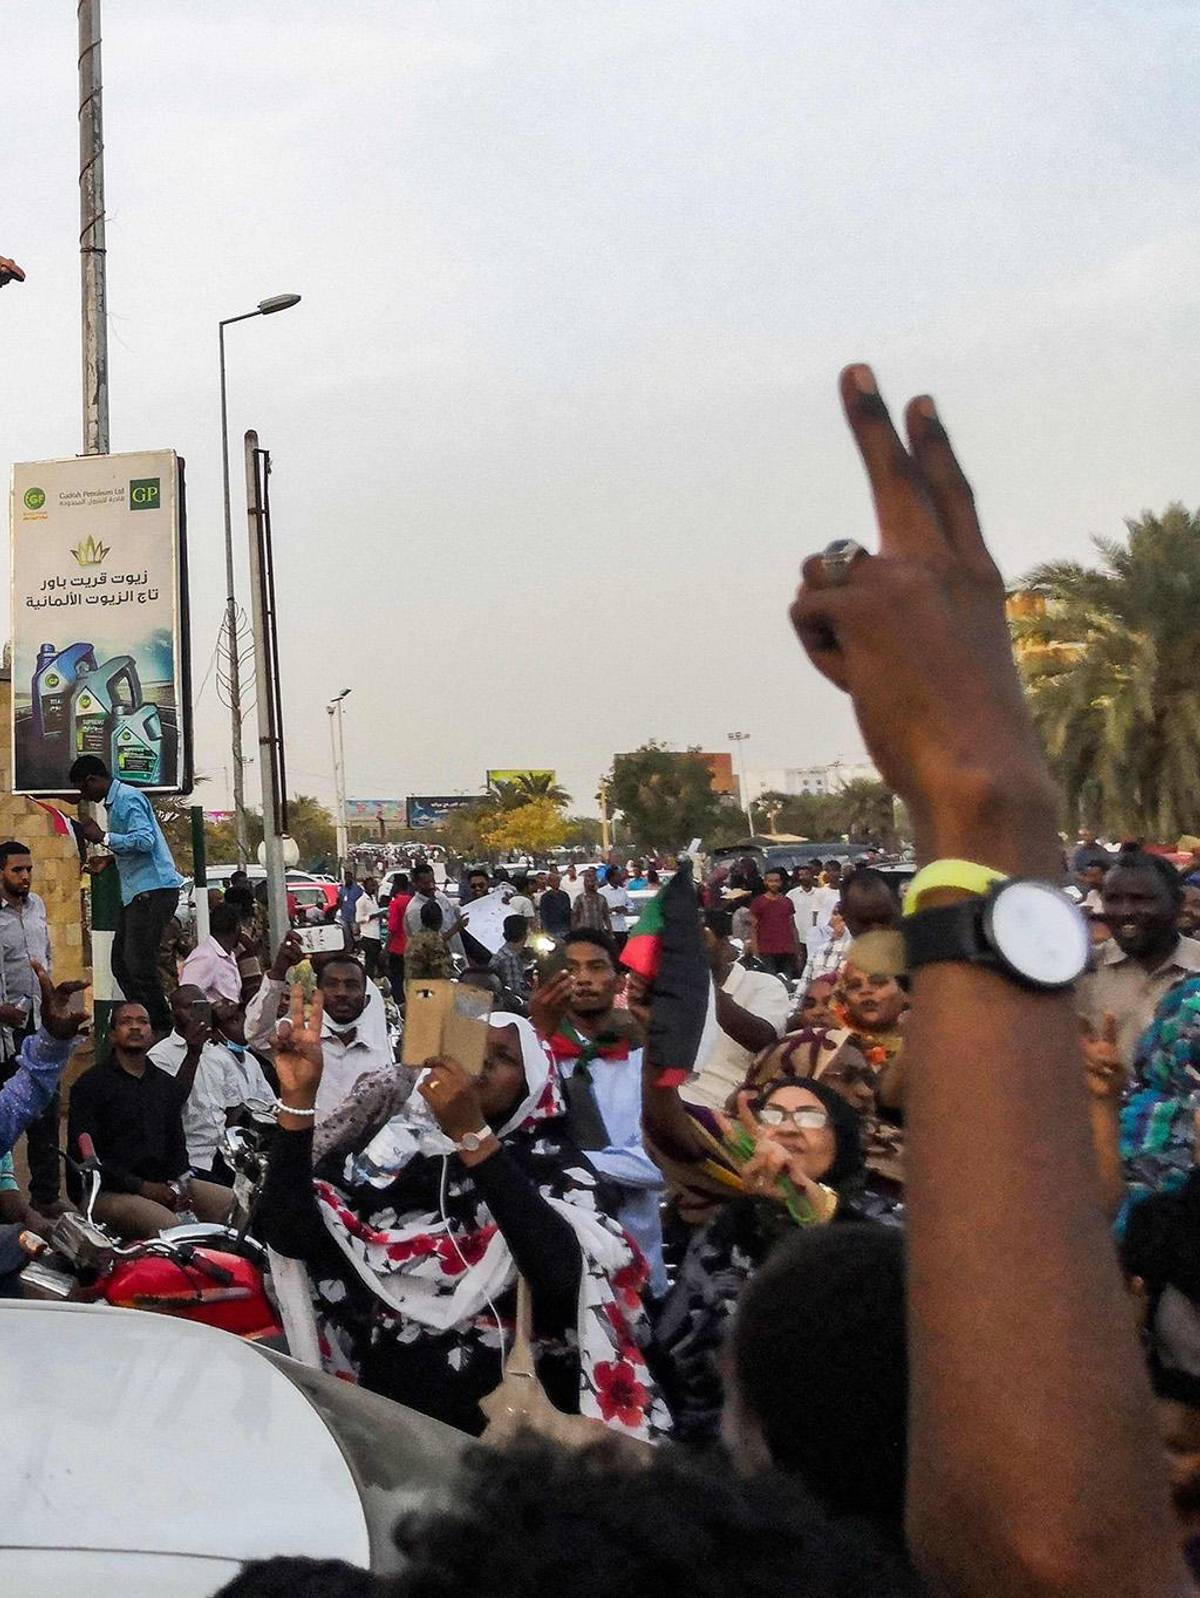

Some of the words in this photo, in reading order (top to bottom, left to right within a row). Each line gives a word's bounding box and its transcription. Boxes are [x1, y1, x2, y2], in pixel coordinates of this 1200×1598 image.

[114, 487, 125, 495] Ltd
[132, 486, 158, 503] GP
[40, 576, 67, 591] باور
[70, 572, 107, 589] قريت
[110, 570, 148, 586] زيوت
[26, 592, 82, 610] الألمانية
[85, 590, 134, 606] الزيوت
[137, 588, 159, 604] تاج
